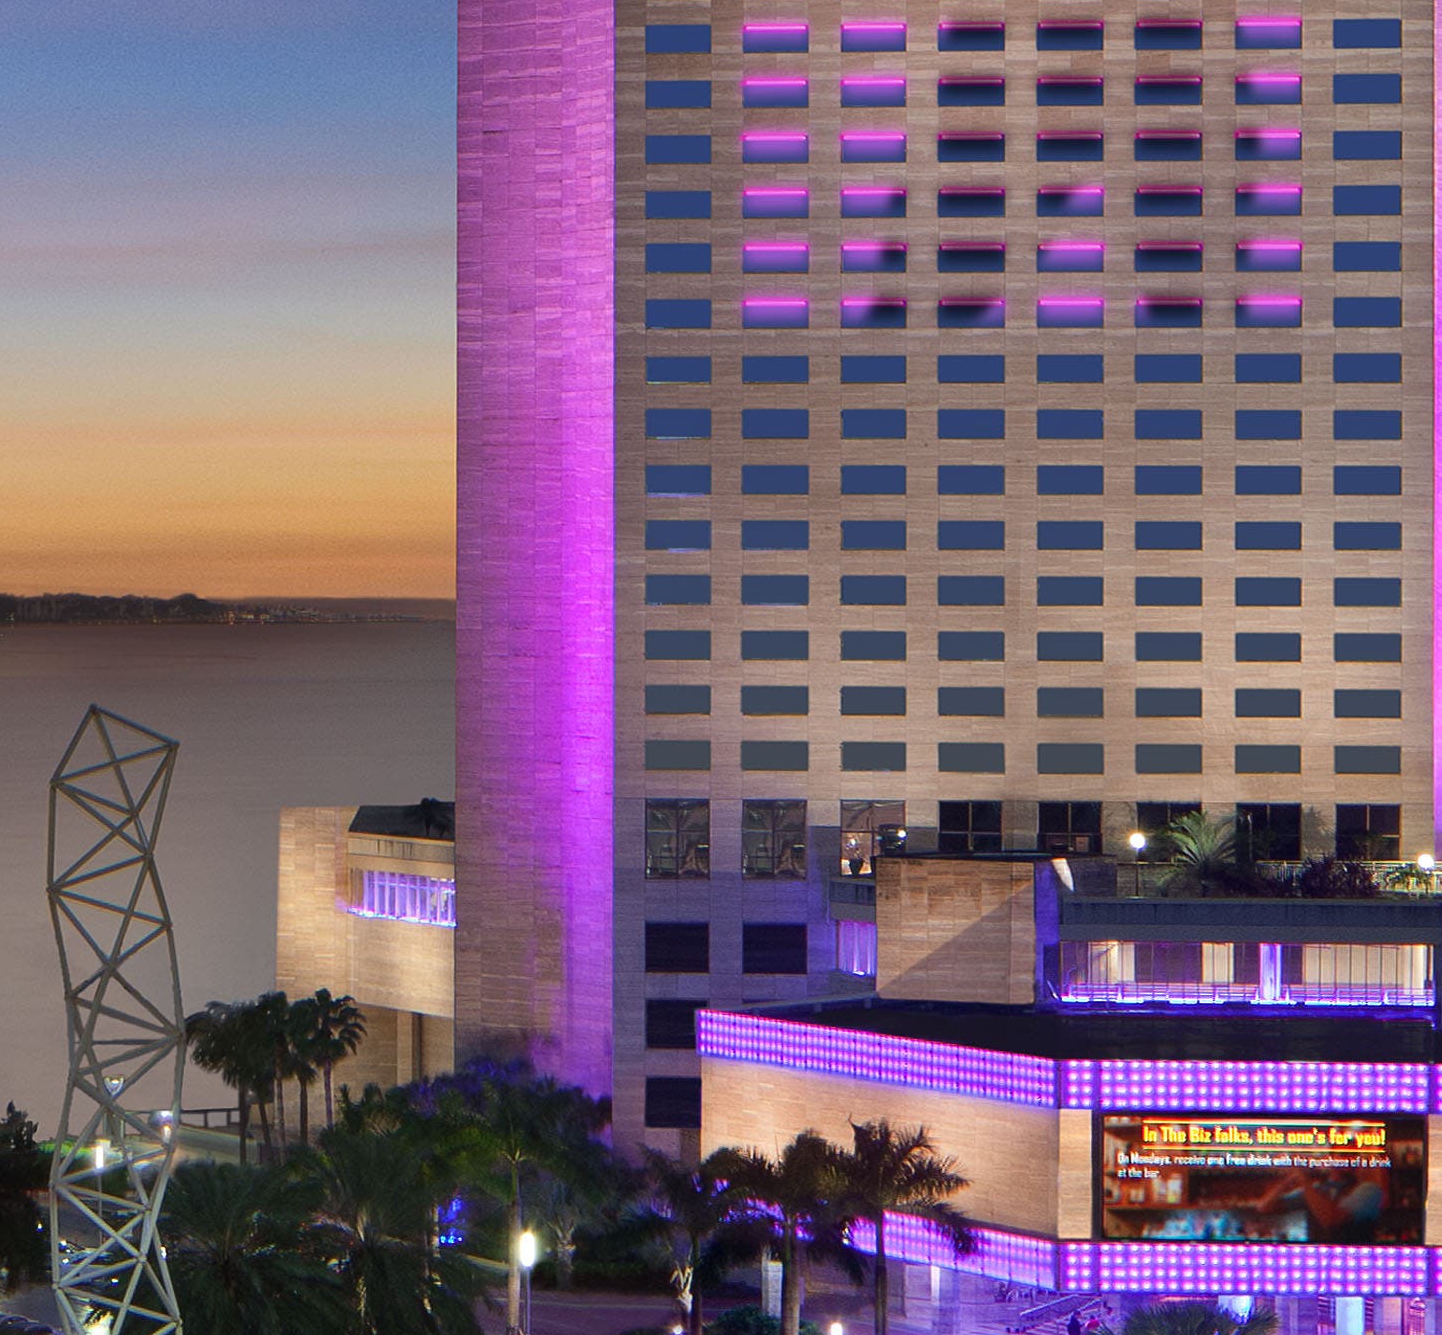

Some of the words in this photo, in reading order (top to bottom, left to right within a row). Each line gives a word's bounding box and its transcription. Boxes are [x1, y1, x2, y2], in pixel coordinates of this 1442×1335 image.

[1142, 1125, 1158, 1143] In
[1160, 1125, 1187, 1143] The
[1188, 1126, 1212, 1144] Biz
[1214, 1126, 1254, 1145] folks,
[1257, 1126, 1285, 1145] this
[1287, 1127, 1326, 1145] one's
[1329, 1127, 1353, 1146] for
[1355, 1128, 1386, 1148] you!
[1226, 1153, 1246, 1166] free
[1293, 1155, 1308, 1167] the
